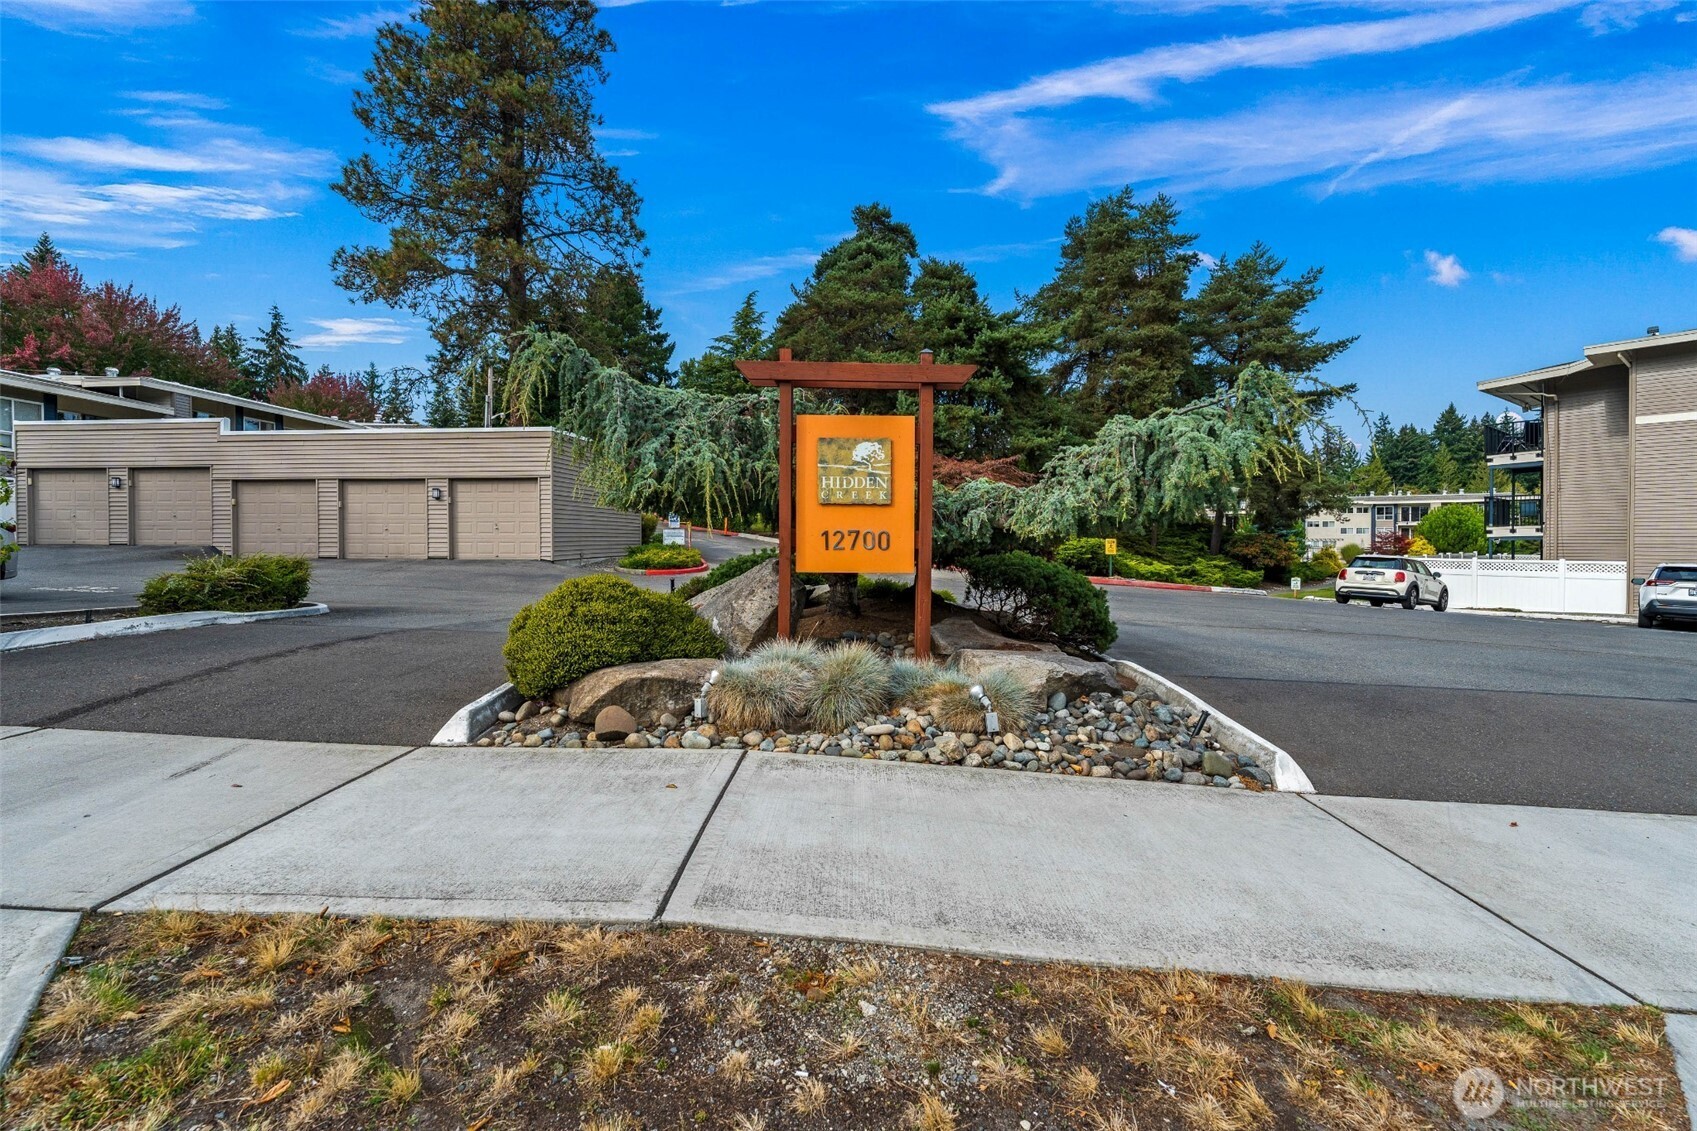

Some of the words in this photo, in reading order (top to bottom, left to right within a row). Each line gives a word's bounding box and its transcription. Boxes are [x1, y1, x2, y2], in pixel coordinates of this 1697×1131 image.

[821, 476, 888, 489] HIDDEN
[821, 490, 888, 500] CREEK
[821, 530, 890, 551] 12700
